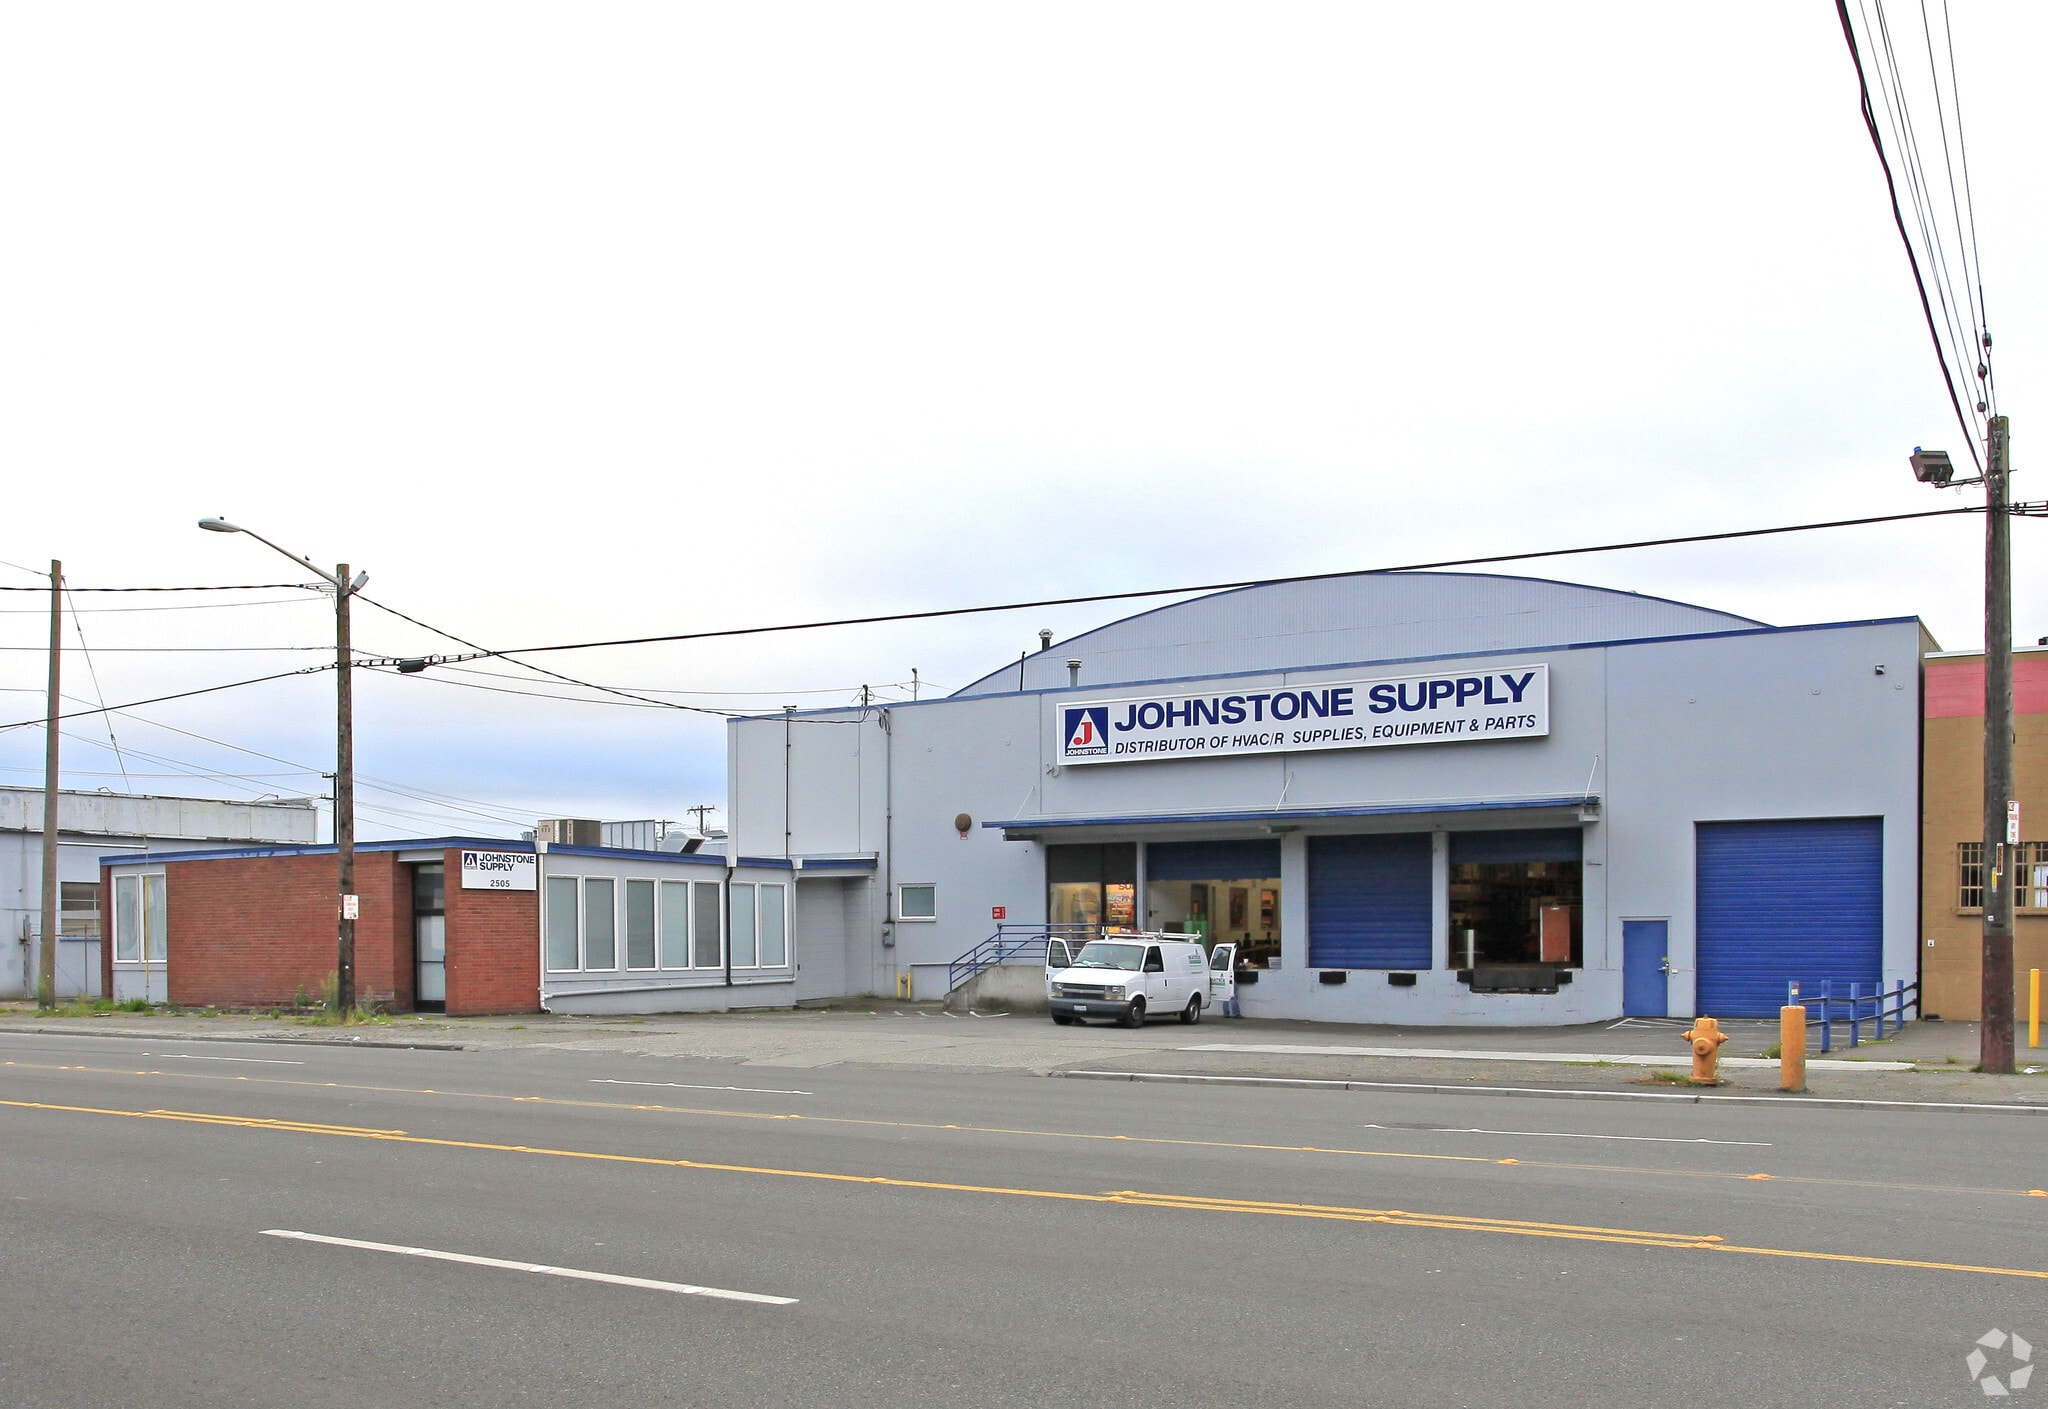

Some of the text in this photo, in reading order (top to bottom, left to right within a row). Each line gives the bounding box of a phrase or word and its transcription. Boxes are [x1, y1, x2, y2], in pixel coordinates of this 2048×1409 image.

[1114, 672, 1536, 732] JOHNSTONE SUPPLY
[1073, 721, 1093, 745] J
[1115, 714, 1537, 754] DISTRIBUTOR OF HVAC/R SUPPLIES, EQUIPMENT & PARTS
[1065, 747, 1108, 756] JOHNSTONE
[479, 853, 535, 864] JOHNSTONE
[479, 862, 515, 872] SUPPLY
[490, 879, 510, 888] 2505
